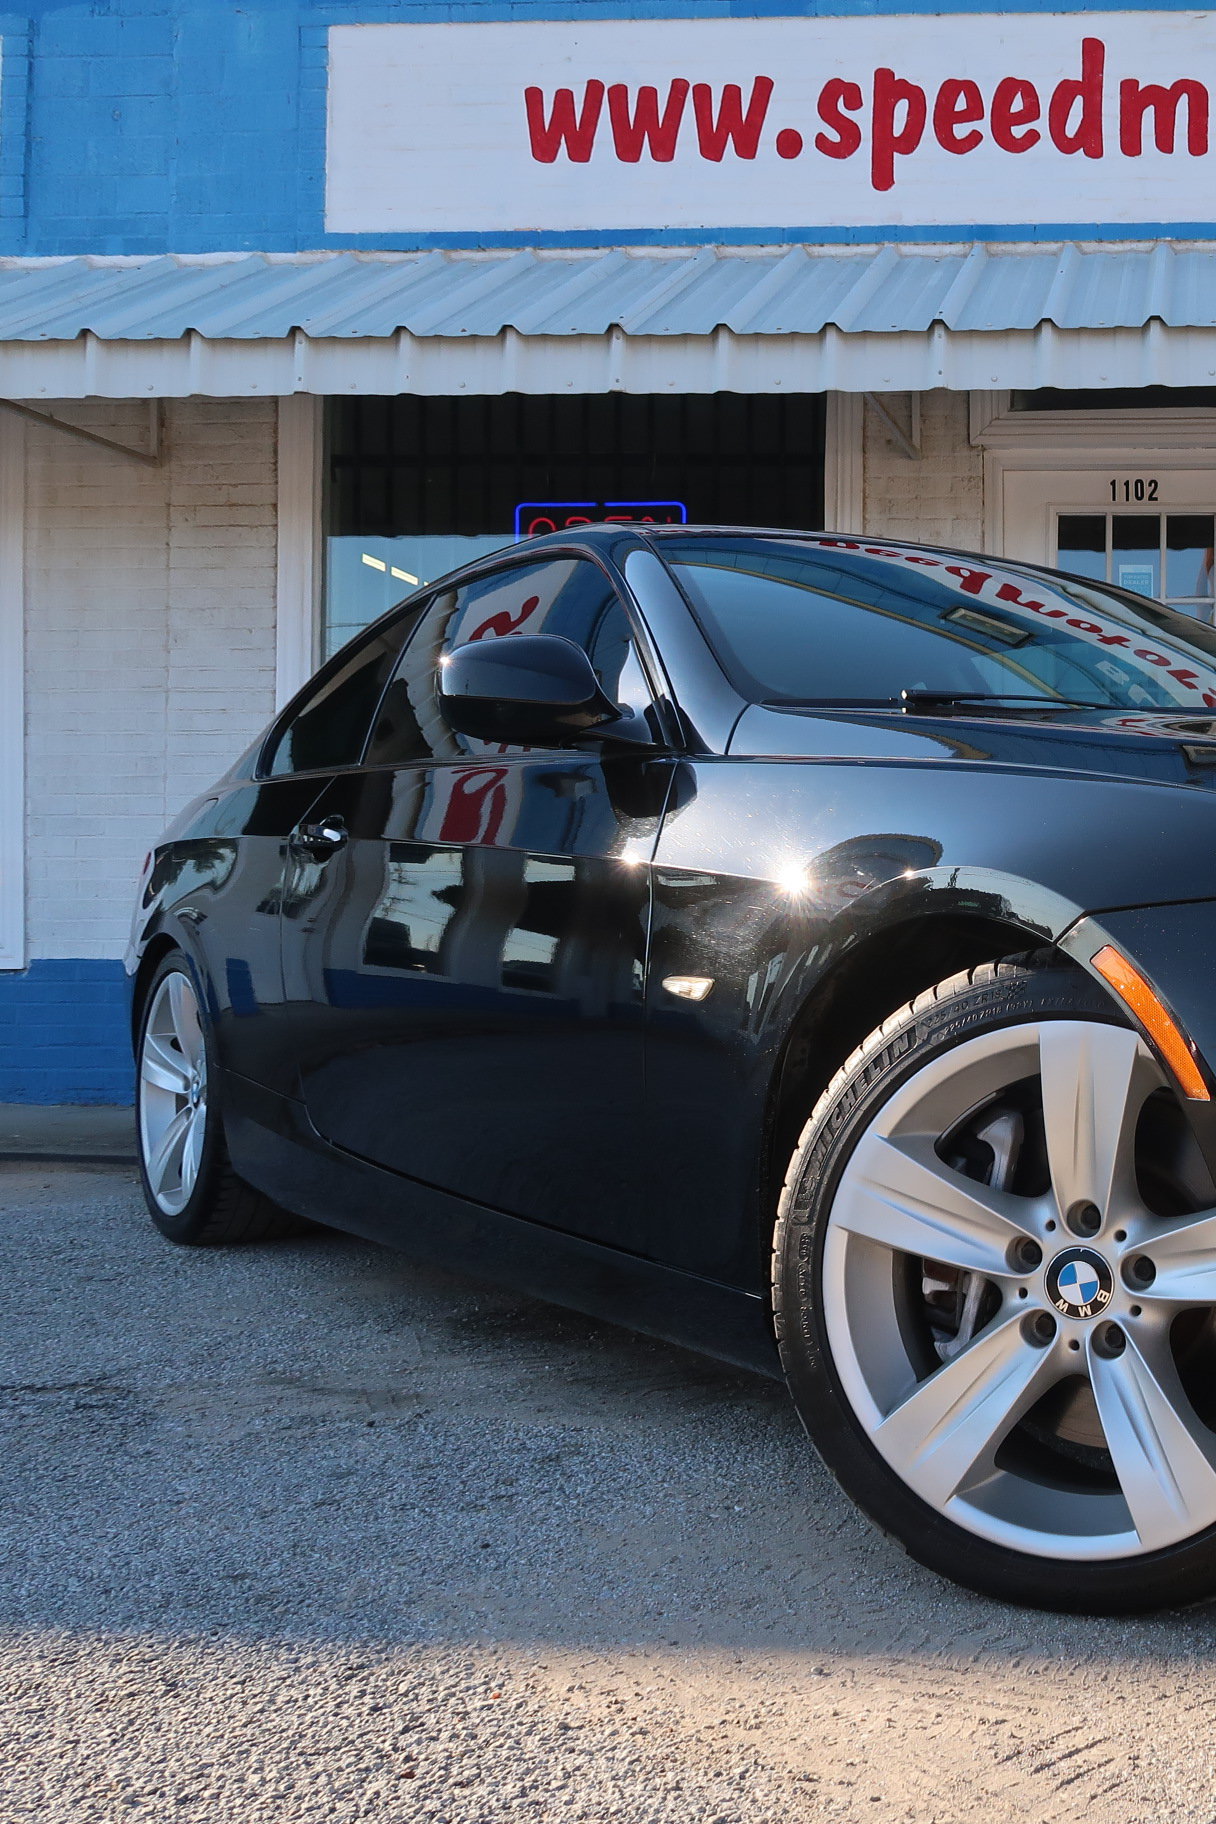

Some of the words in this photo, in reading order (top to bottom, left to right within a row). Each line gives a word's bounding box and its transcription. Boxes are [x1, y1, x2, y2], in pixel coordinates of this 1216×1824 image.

[1109, 478, 1159, 502] 1102
[808, 1033, 910, 1178] MICHELIN
[1055, 1289, 1111, 1317] BMW
